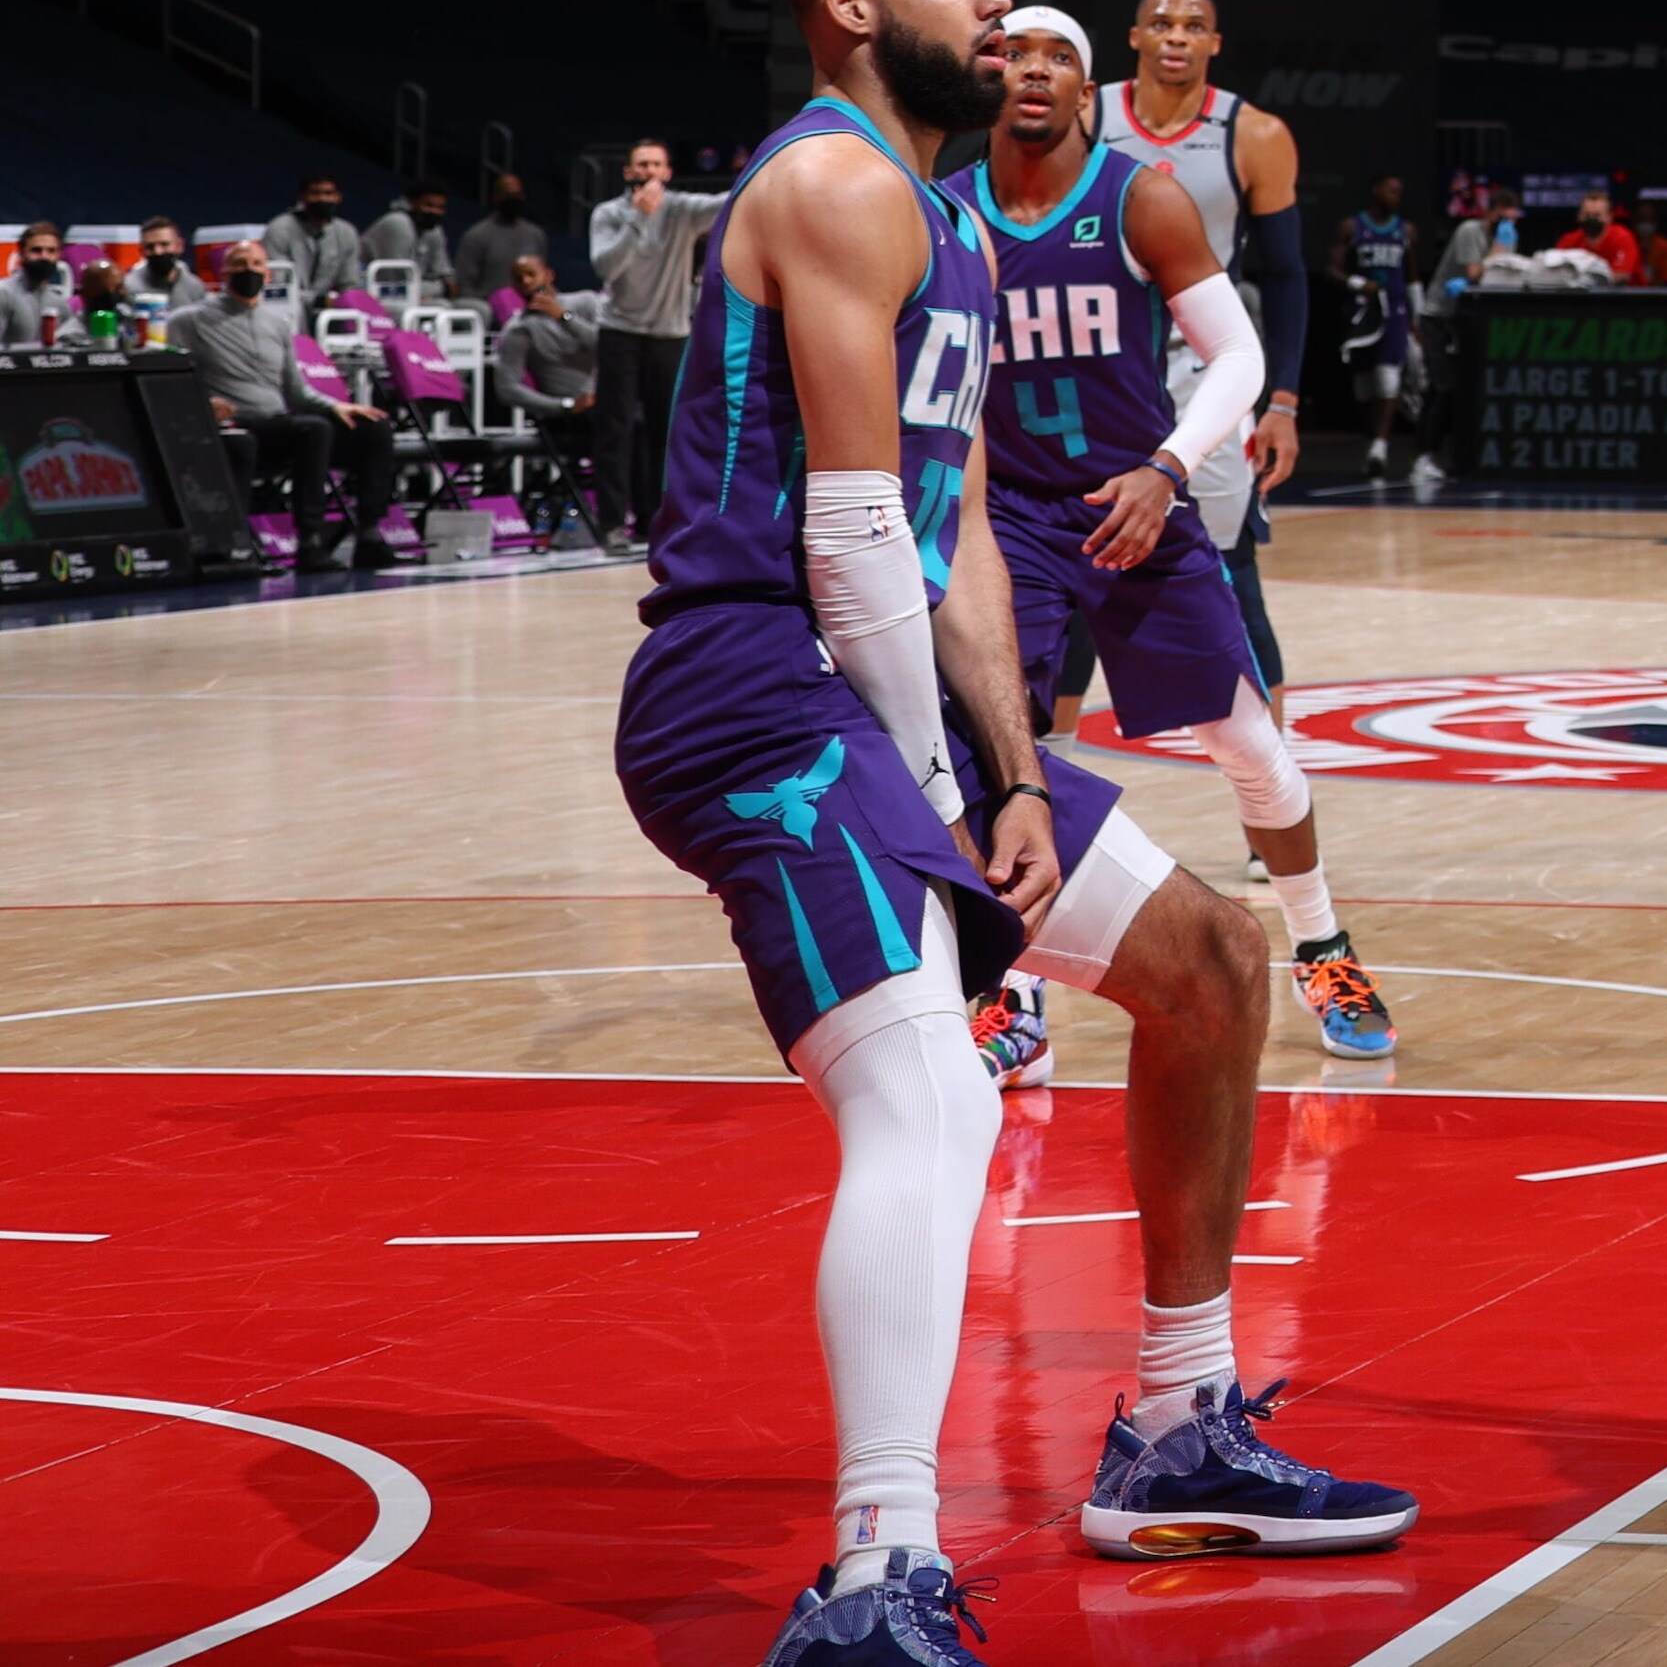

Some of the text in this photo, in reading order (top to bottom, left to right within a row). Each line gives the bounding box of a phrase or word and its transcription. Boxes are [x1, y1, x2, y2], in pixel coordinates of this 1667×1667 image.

[1261, 69, 1403, 108] NOW
[1484, 367, 1591, 399] LARGE
[1012, 377, 1090, 459] 4
[1481, 403, 1503, 433] A
[1511, 405, 1654, 436] PAPADIA
[1480, 438, 1640, 472] A 2 LITER
